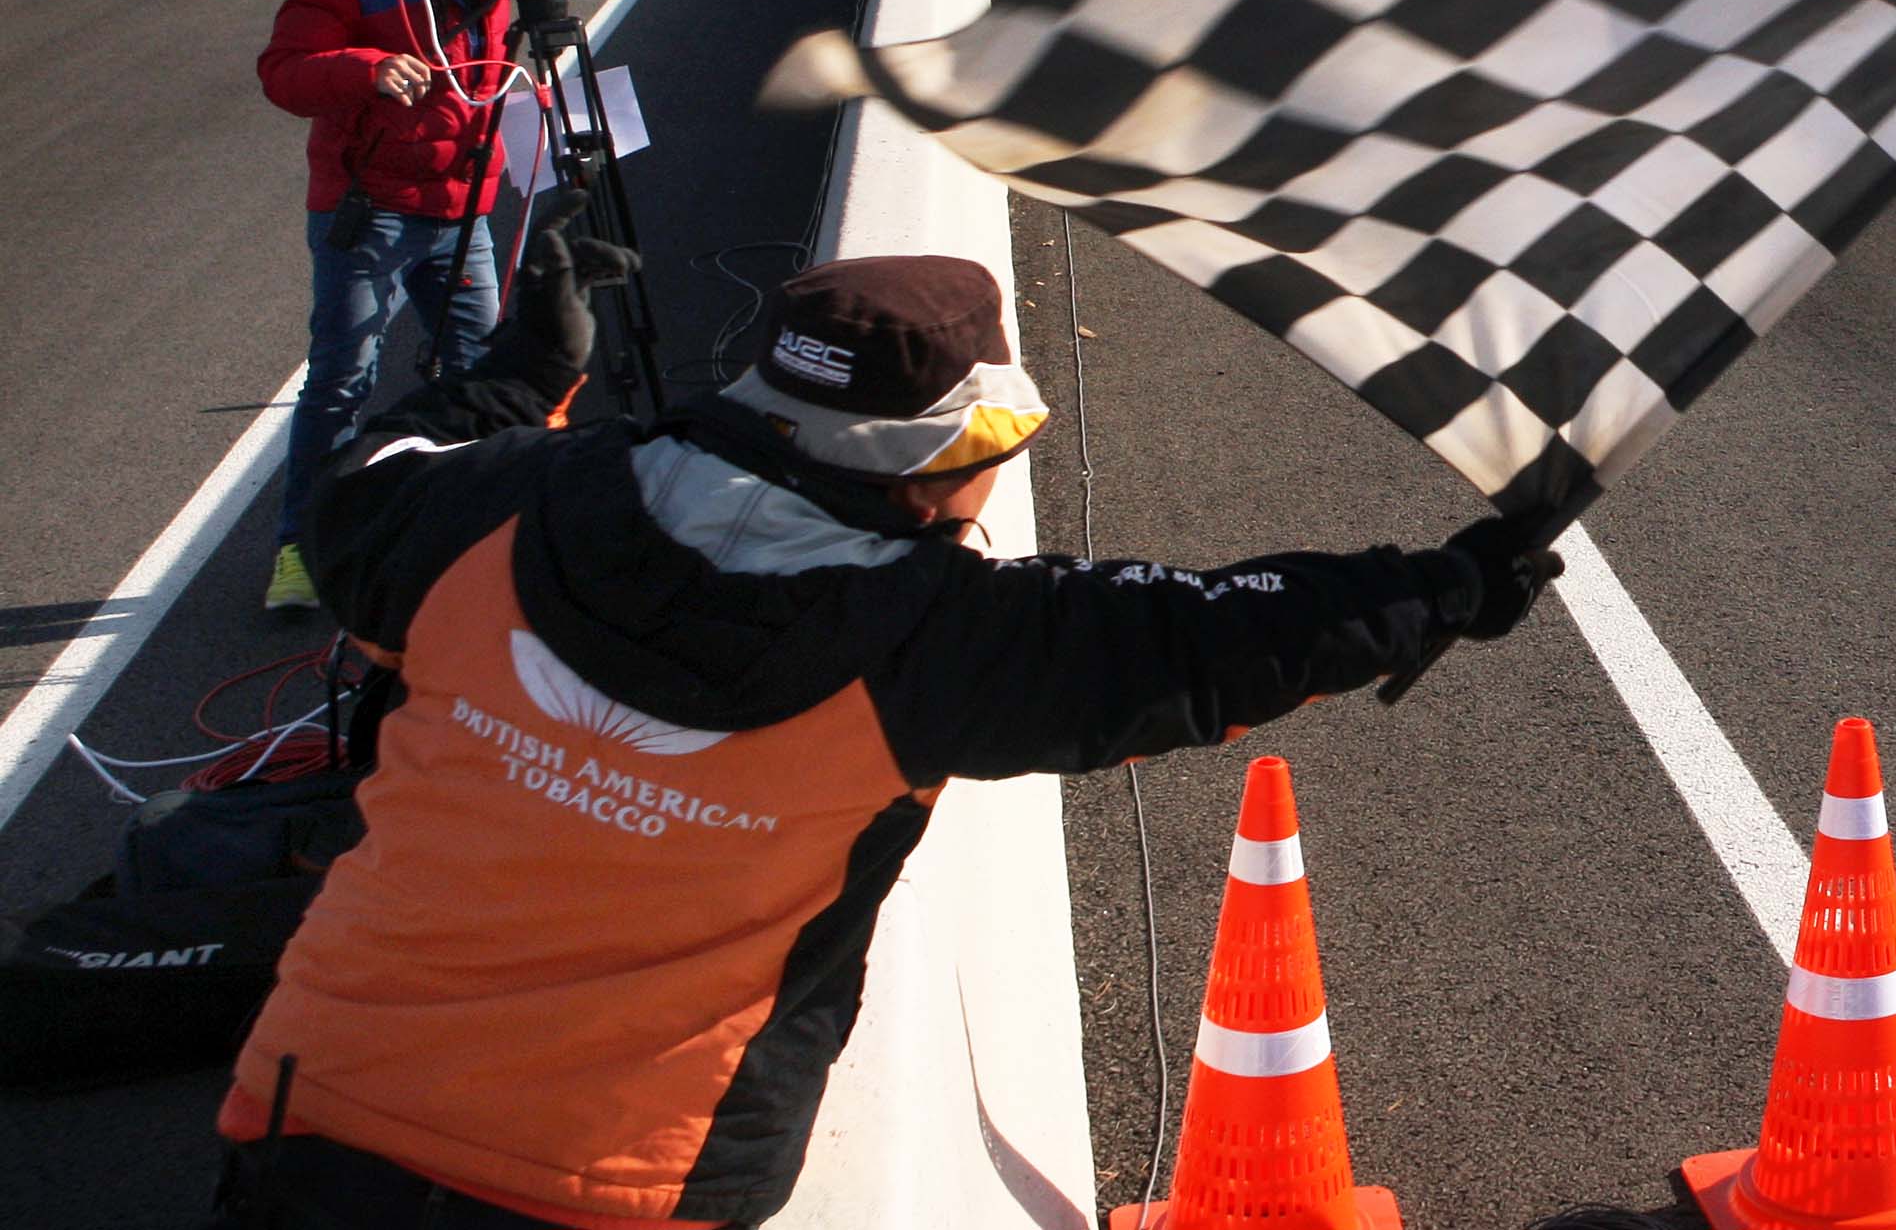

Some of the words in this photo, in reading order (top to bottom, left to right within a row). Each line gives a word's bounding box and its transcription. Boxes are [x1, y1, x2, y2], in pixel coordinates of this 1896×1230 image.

[1232, 571, 1286, 593] PRIX
[452, 696, 566, 771] BRITISH
[575, 757, 778, 833] AMERICAN
[501, 754, 668, 839] TOBACCO
[78, 943, 225, 969] GIANT
